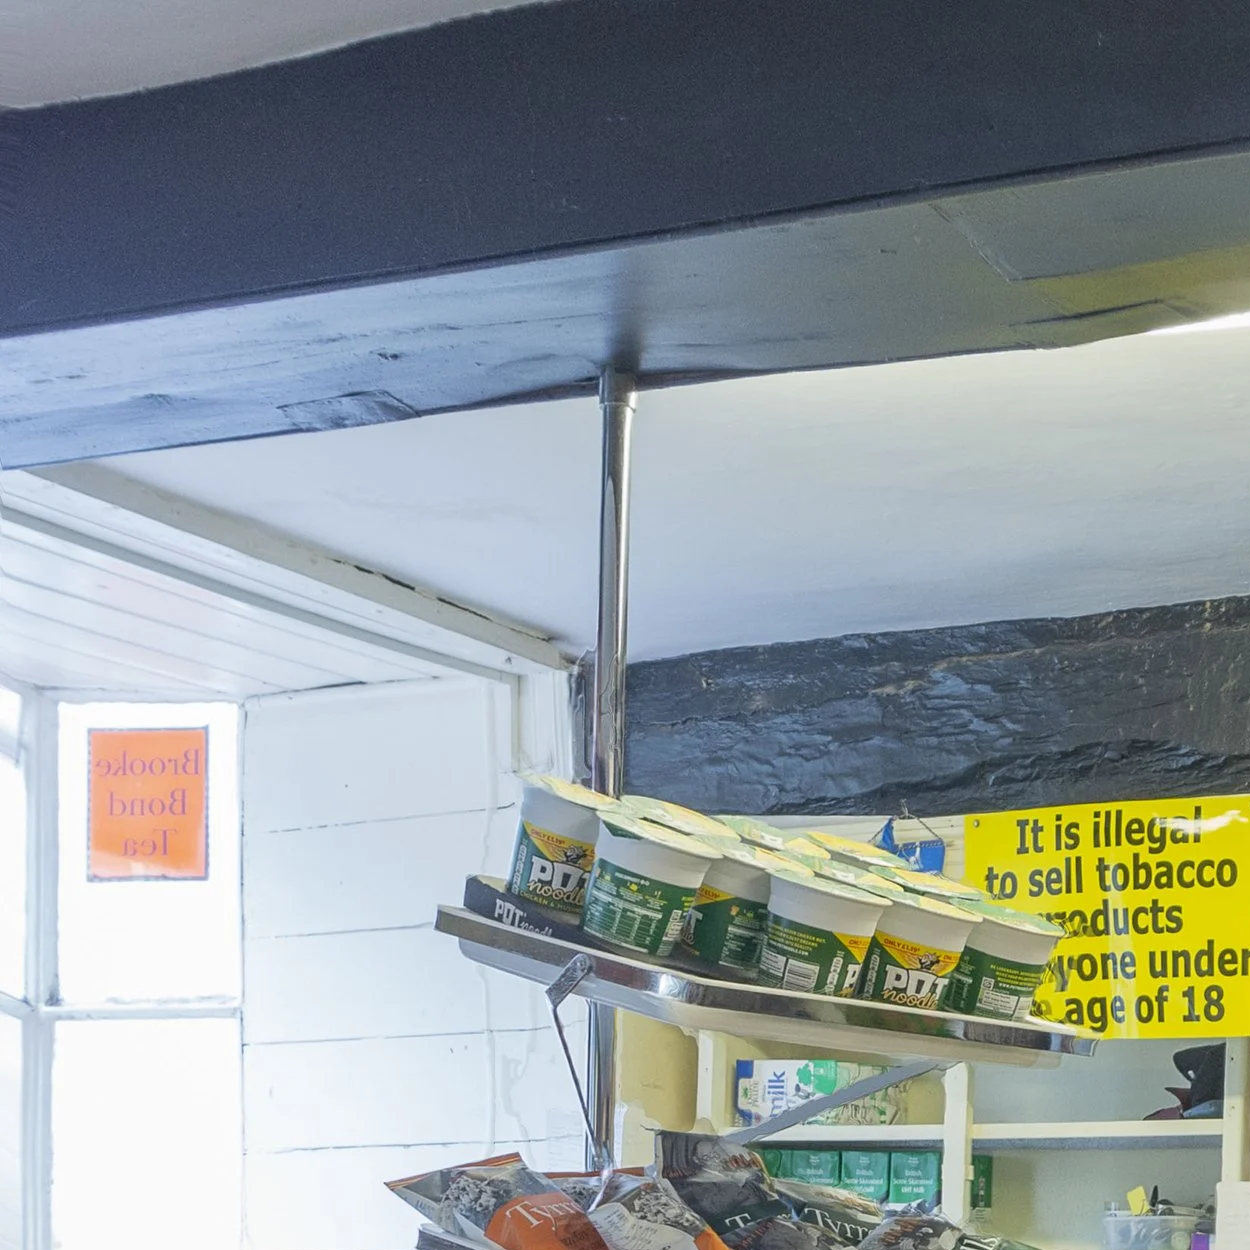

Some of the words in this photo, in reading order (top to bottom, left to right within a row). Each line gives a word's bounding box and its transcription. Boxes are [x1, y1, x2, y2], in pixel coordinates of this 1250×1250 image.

[1016, 818, 1044, 855] It
[1055, 814, 1080, 851] is
[1092, 805, 1201, 854] illegal
[985, 866, 1018, 899] to
[1028, 856, 1083, 897] sell
[1096, 852, 1238, 892] tobacco
[1040, 898, 1184, 937] roducts
[884, 964, 950, 1001] POT
[1065, 994, 1126, 1033] age
[1135, 984, 1169, 1022] of
[1182, 984, 1225, 1023] 18
